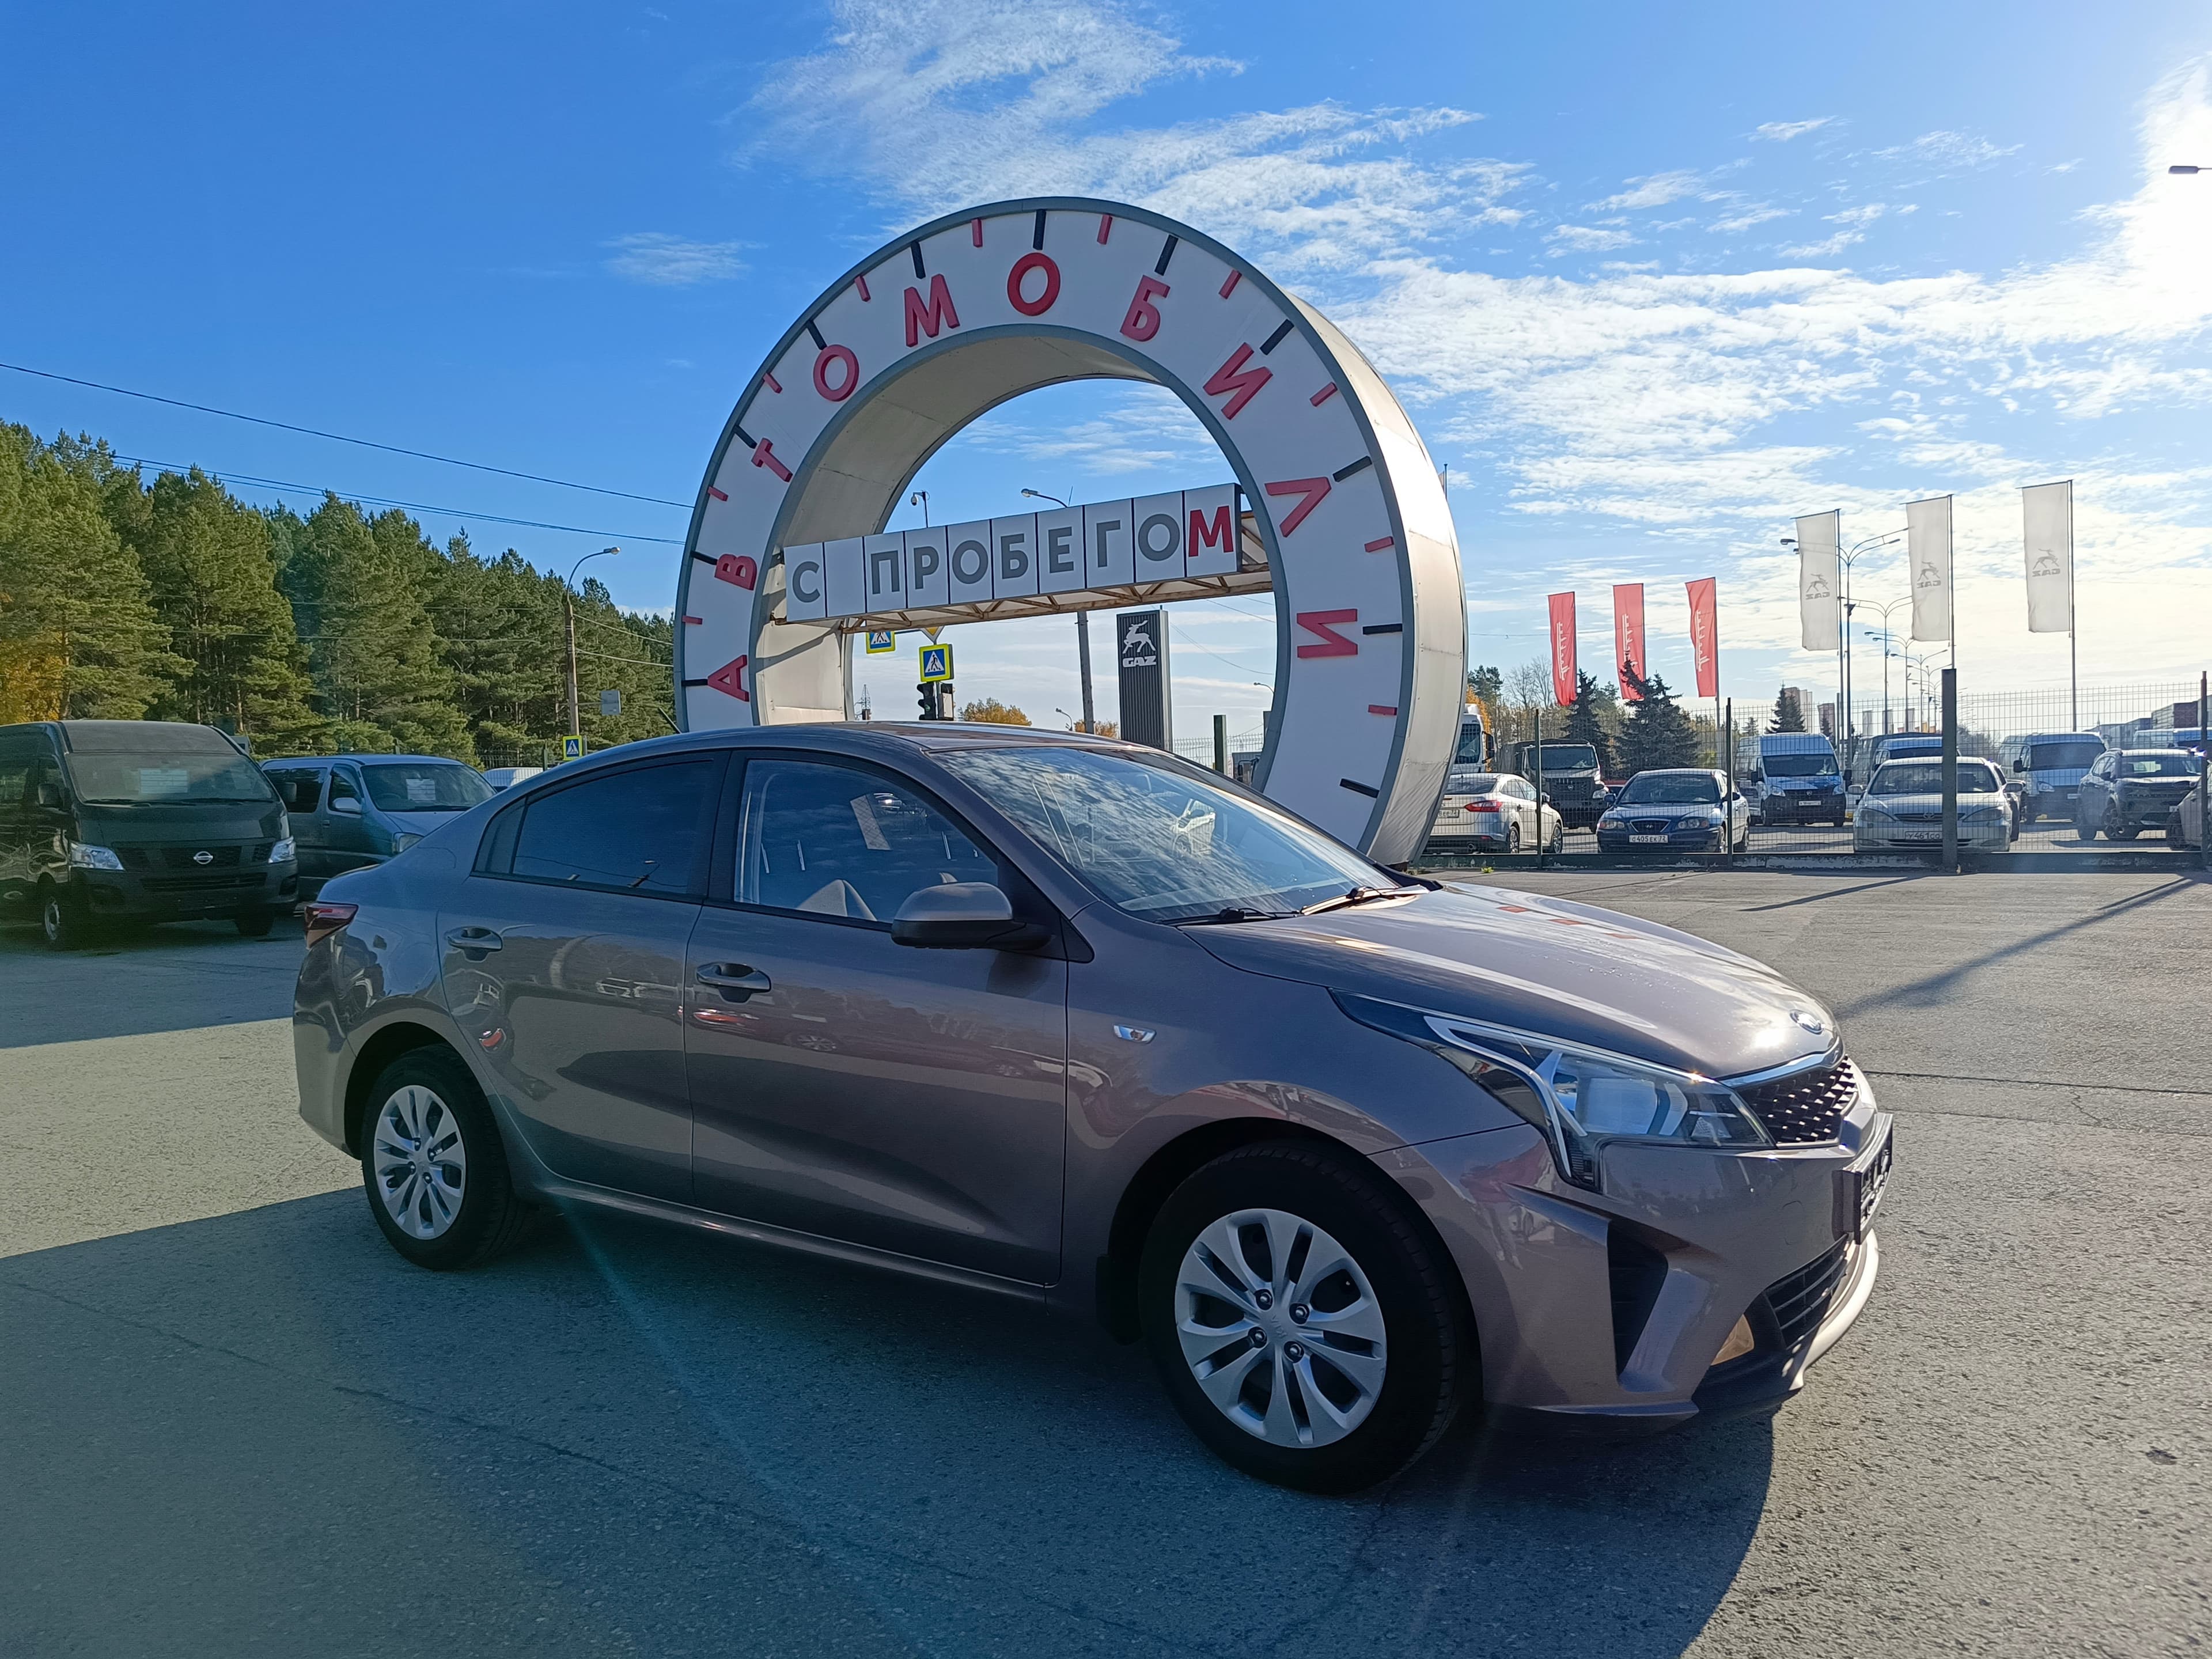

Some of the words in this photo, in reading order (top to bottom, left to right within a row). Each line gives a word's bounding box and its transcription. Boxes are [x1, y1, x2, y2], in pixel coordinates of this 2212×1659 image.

[707, 252, 1358, 702] АВТОМОБИЛИ
[792, 560, 821, 603] С
[870, 505, 1234, 594] ПРОБЕГОМ
[1122, 656, 1157, 668] GAZ
